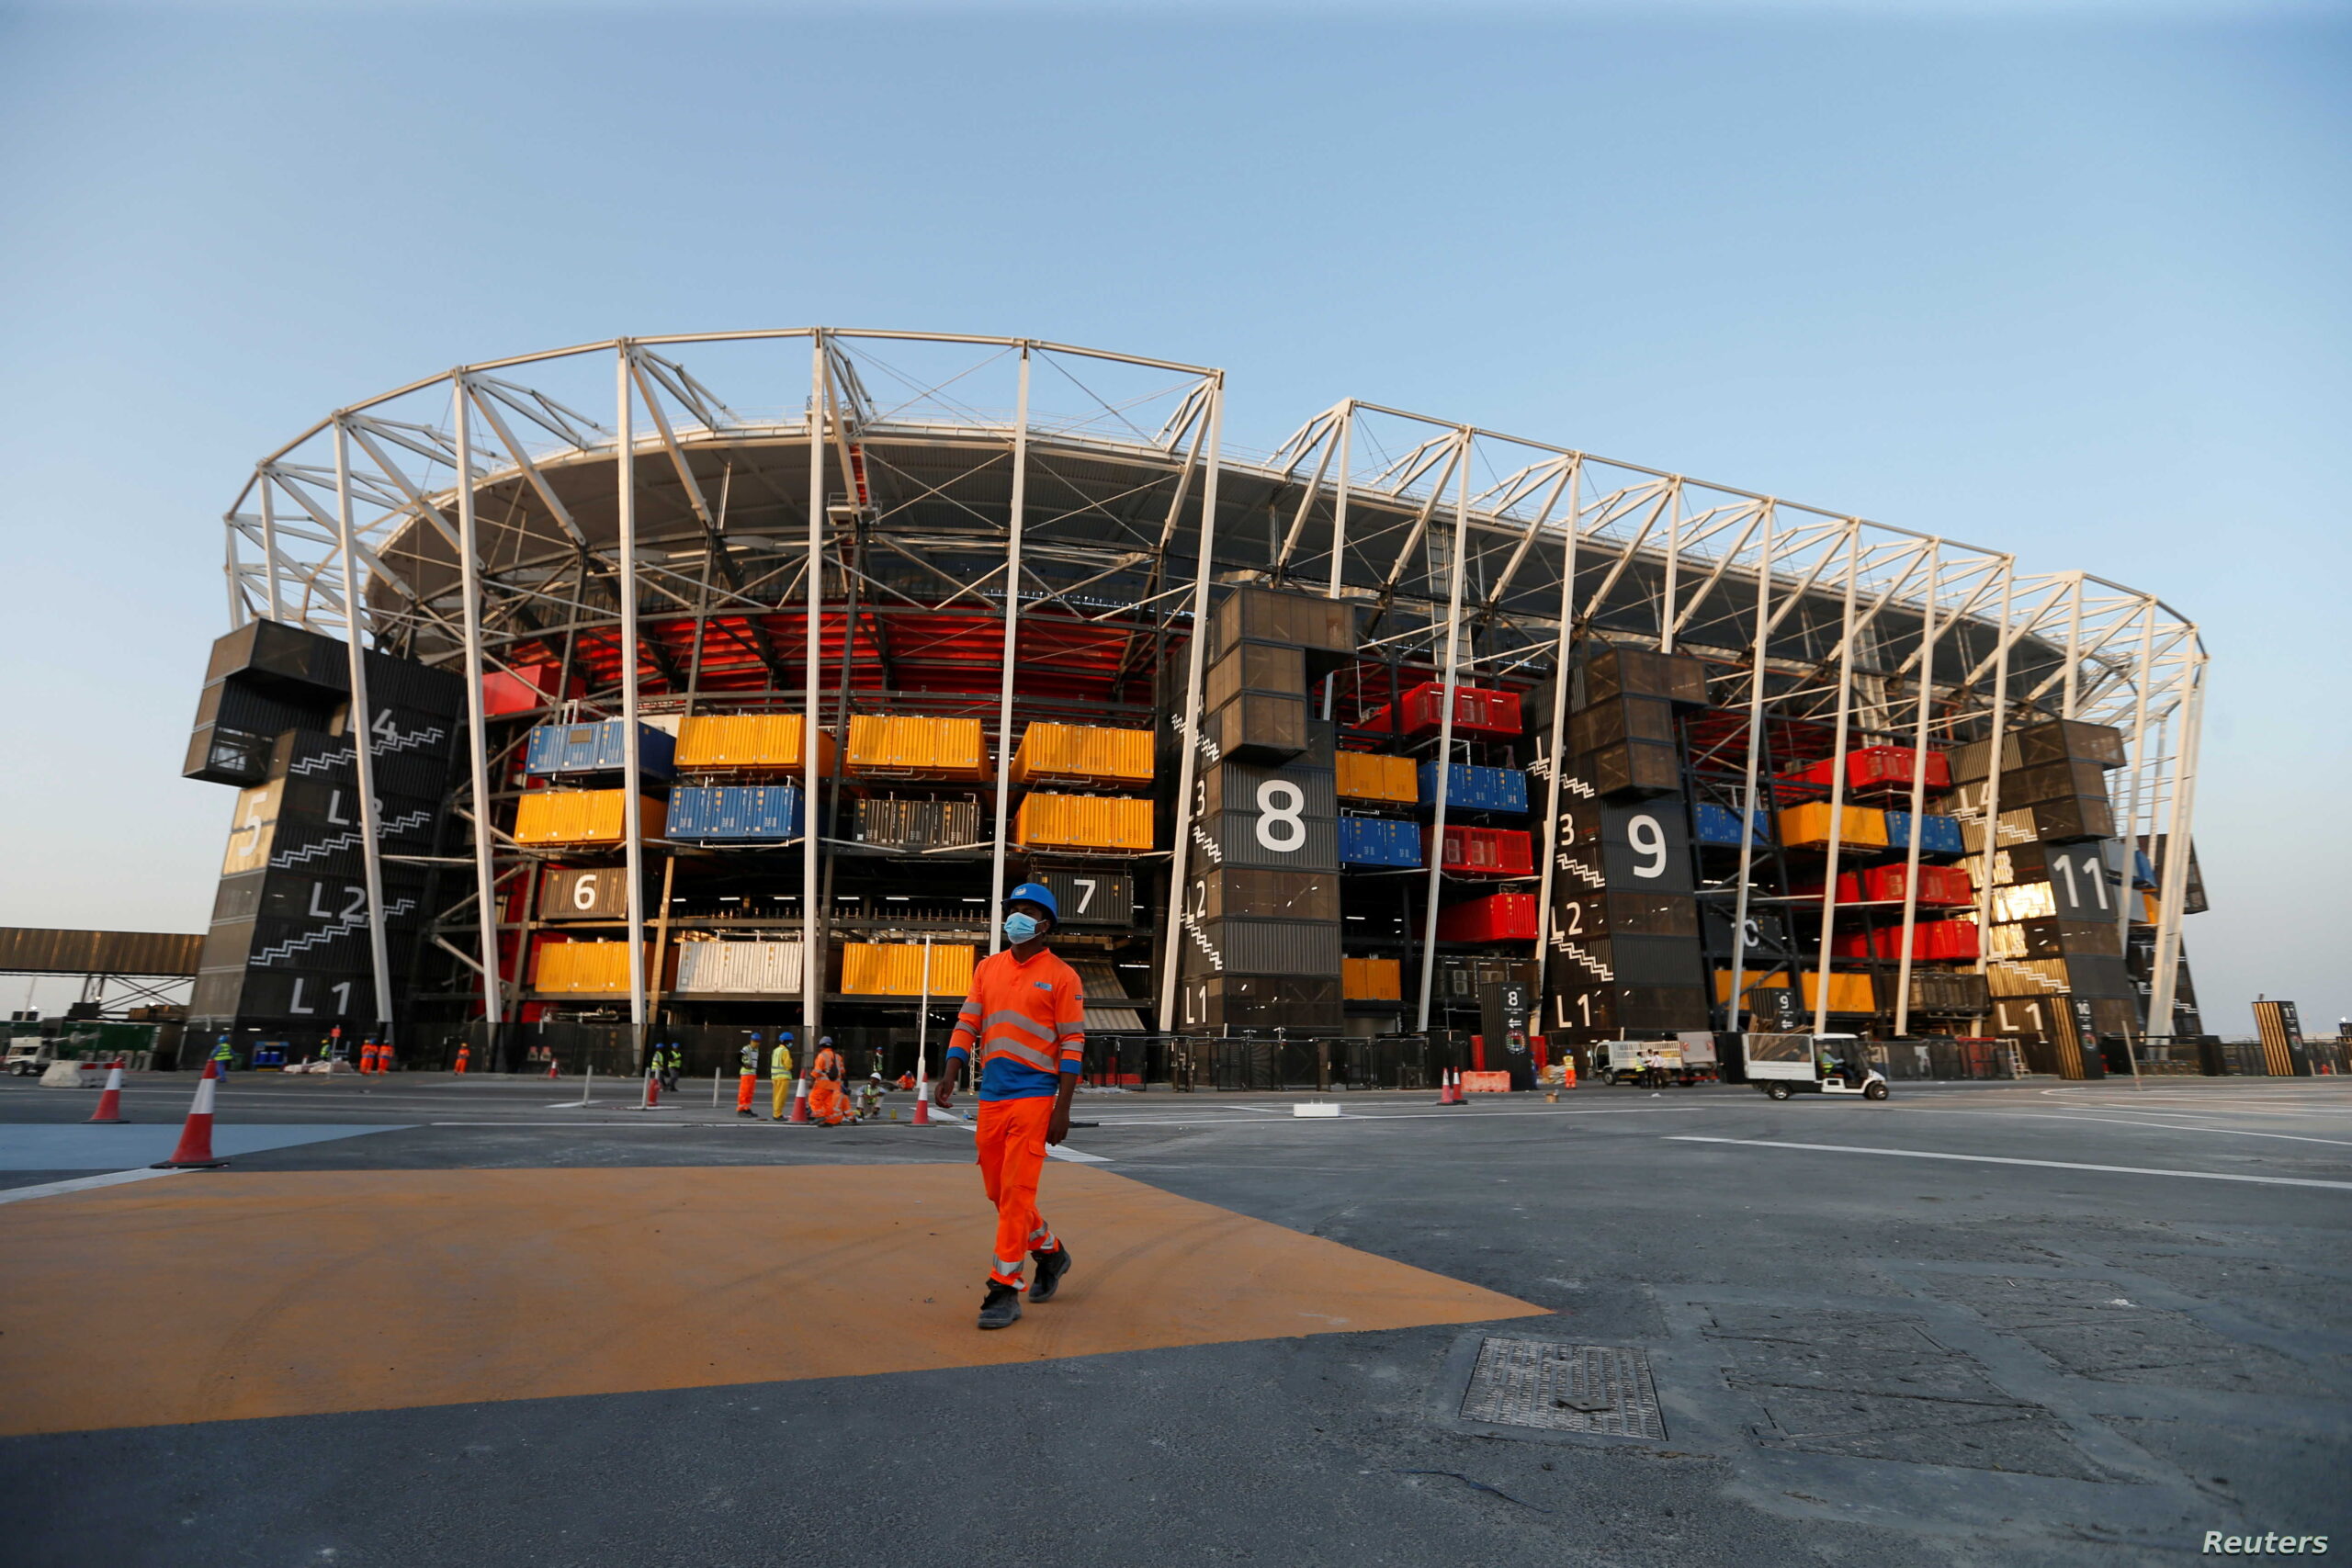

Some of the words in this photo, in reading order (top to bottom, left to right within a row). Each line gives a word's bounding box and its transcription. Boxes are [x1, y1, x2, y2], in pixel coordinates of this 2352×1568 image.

[239, 792, 267, 856] 5
[1256, 779, 1306, 852] 8
[1627, 815, 1667, 878] 9
[573, 874, 597, 910] 6
[1073, 879, 1096, 914] 7
[2052, 854, 2109, 909] 11
[309, 882, 367, 923] L2
[1186, 880, 1206, 924] L2
[1551, 901, 1583, 938] L2
[1186, 985, 1206, 1024] L1
[1508, 991, 1518, 1006] 8
[1556, 993, 1590, 1028] L1
[1779, 995, 1789, 1010] 9
[1998, 1002, 2043, 1031] L1
